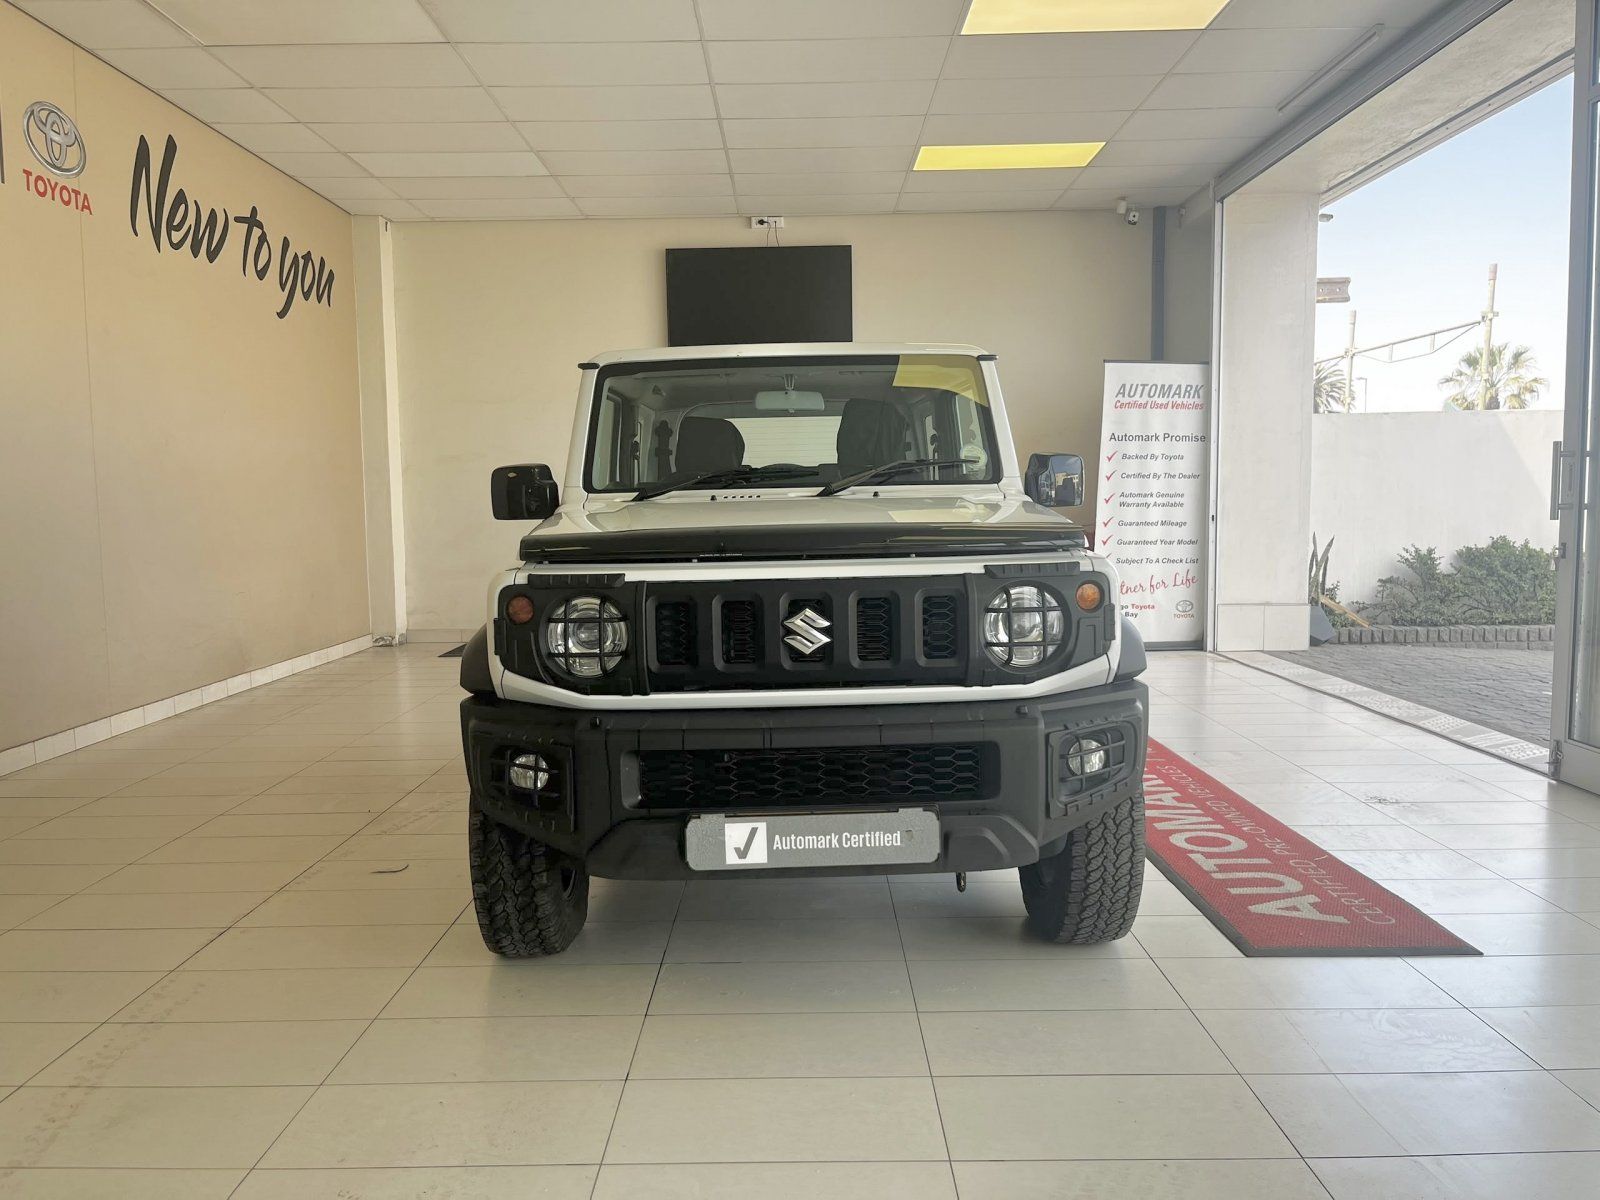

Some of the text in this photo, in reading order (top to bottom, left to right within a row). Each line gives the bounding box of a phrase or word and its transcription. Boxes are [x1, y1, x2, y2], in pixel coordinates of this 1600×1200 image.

[22, 168, 94, 216] TOYOTA
[130, 134, 335, 320] New to you
[1115, 383, 1205, 399] AUTOMARK
[1114, 400, 1204, 410] Certified Used Vehicles
[1109, 432, 1206, 443] Automark Promise
[1150, 453, 1158, 461] By
[1161, 453, 1185, 461] Toyota
[1120, 472, 1151, 480] Certified
[1152, 473, 1161, 481] By
[1160, 520, 1188, 528] Mileage
[1119, 569, 1199, 595] tner for Life
[1131, 603, 1155, 611] Toyota
[773, 830, 901, 851] Automark Certified
[1289, 859, 1396, 925] CERTIFIED
